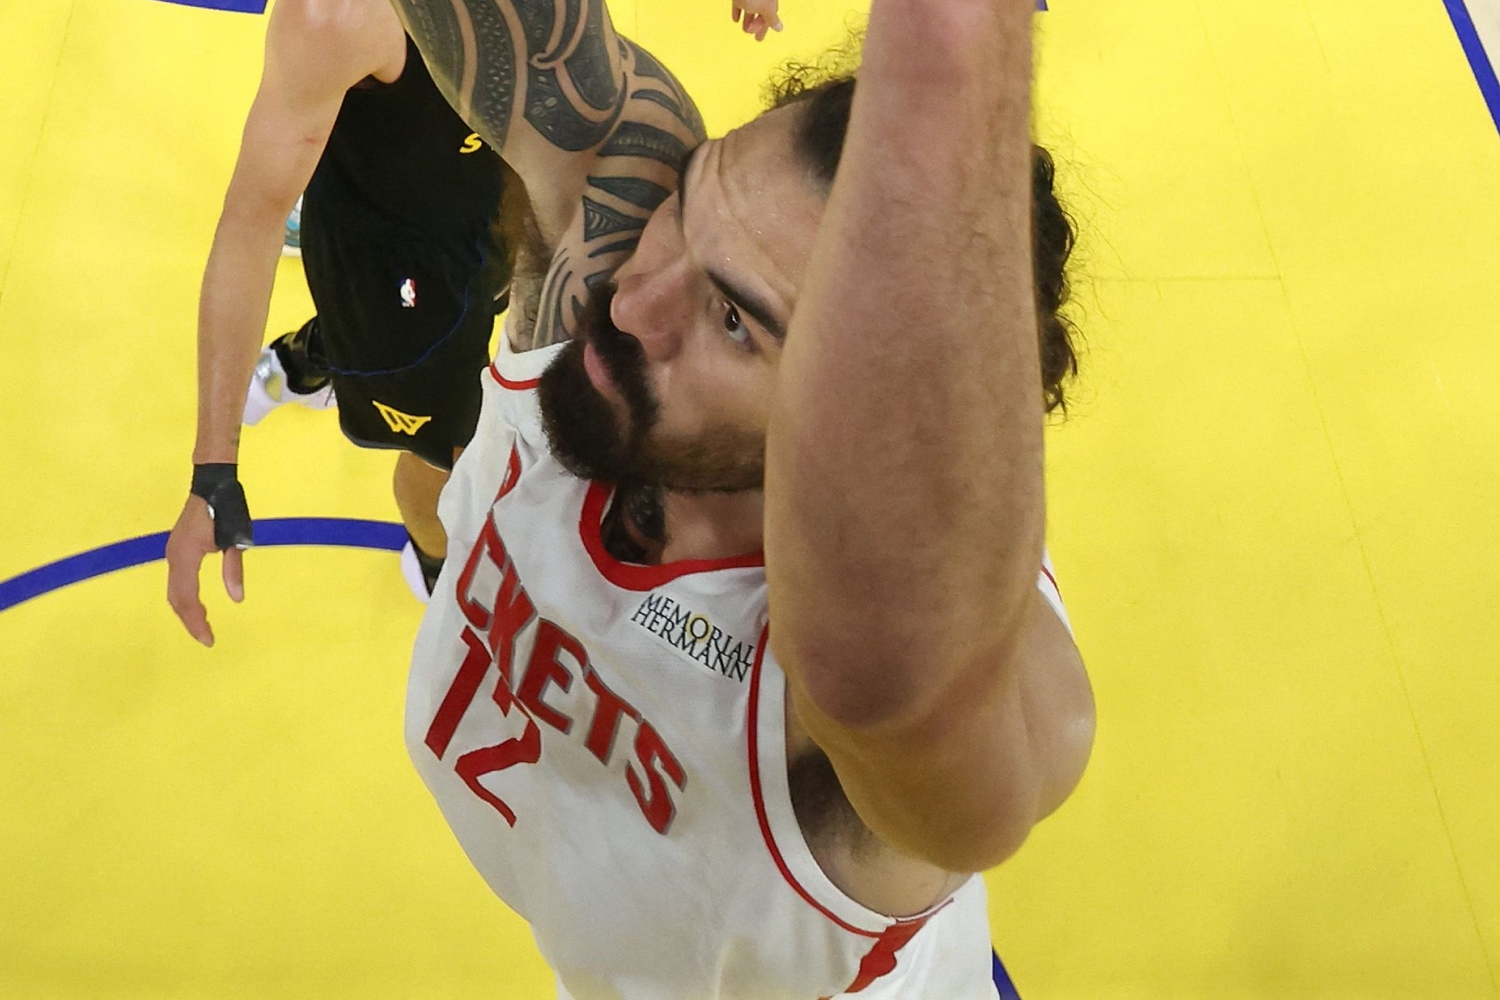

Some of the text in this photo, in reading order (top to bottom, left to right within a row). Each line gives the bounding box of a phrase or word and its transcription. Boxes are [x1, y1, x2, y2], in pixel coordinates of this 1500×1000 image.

[630, 603, 753, 684] HERMANN
[643, 593, 756, 666] MEMORIAL
[424, 625, 542, 829] 12
